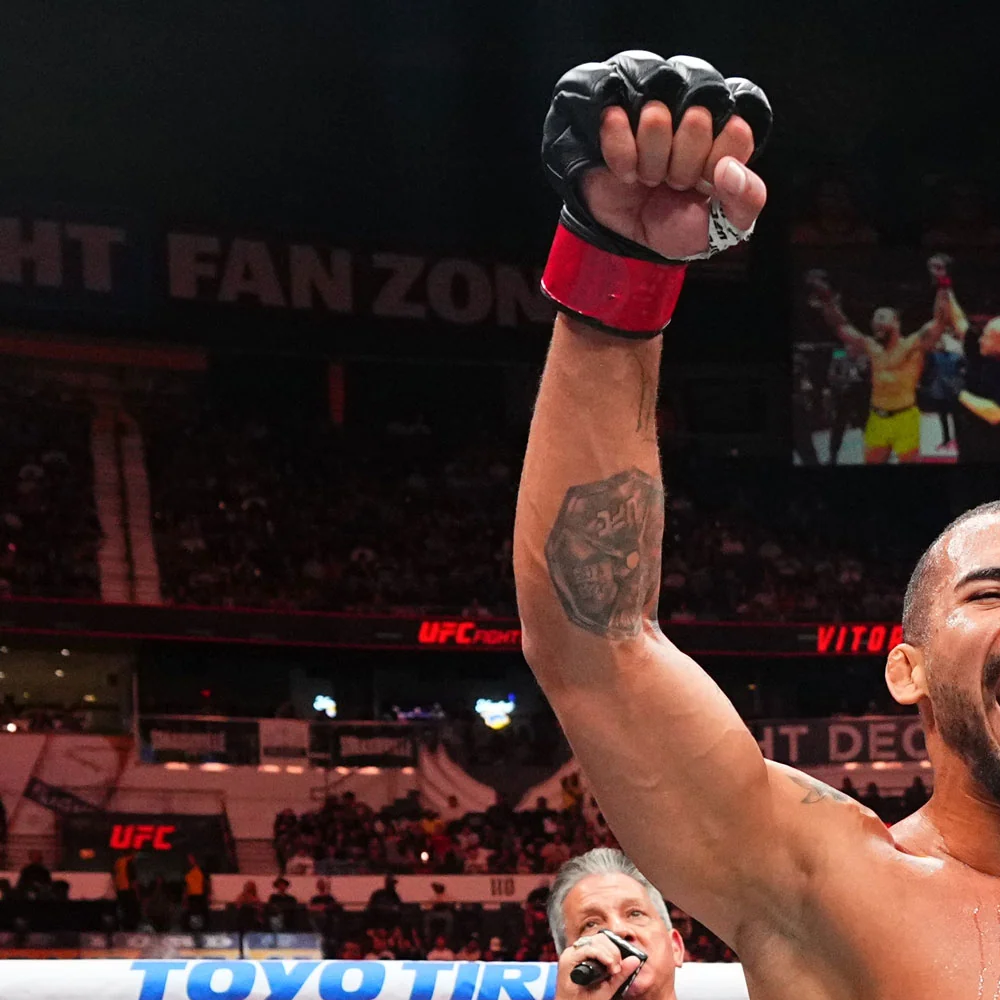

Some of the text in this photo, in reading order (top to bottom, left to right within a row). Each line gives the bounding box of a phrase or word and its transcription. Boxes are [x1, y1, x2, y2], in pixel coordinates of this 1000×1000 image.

[167, 233, 354, 312] FAN
[418, 621, 475, 645] UFC
[110, 824, 176, 850] UFC
